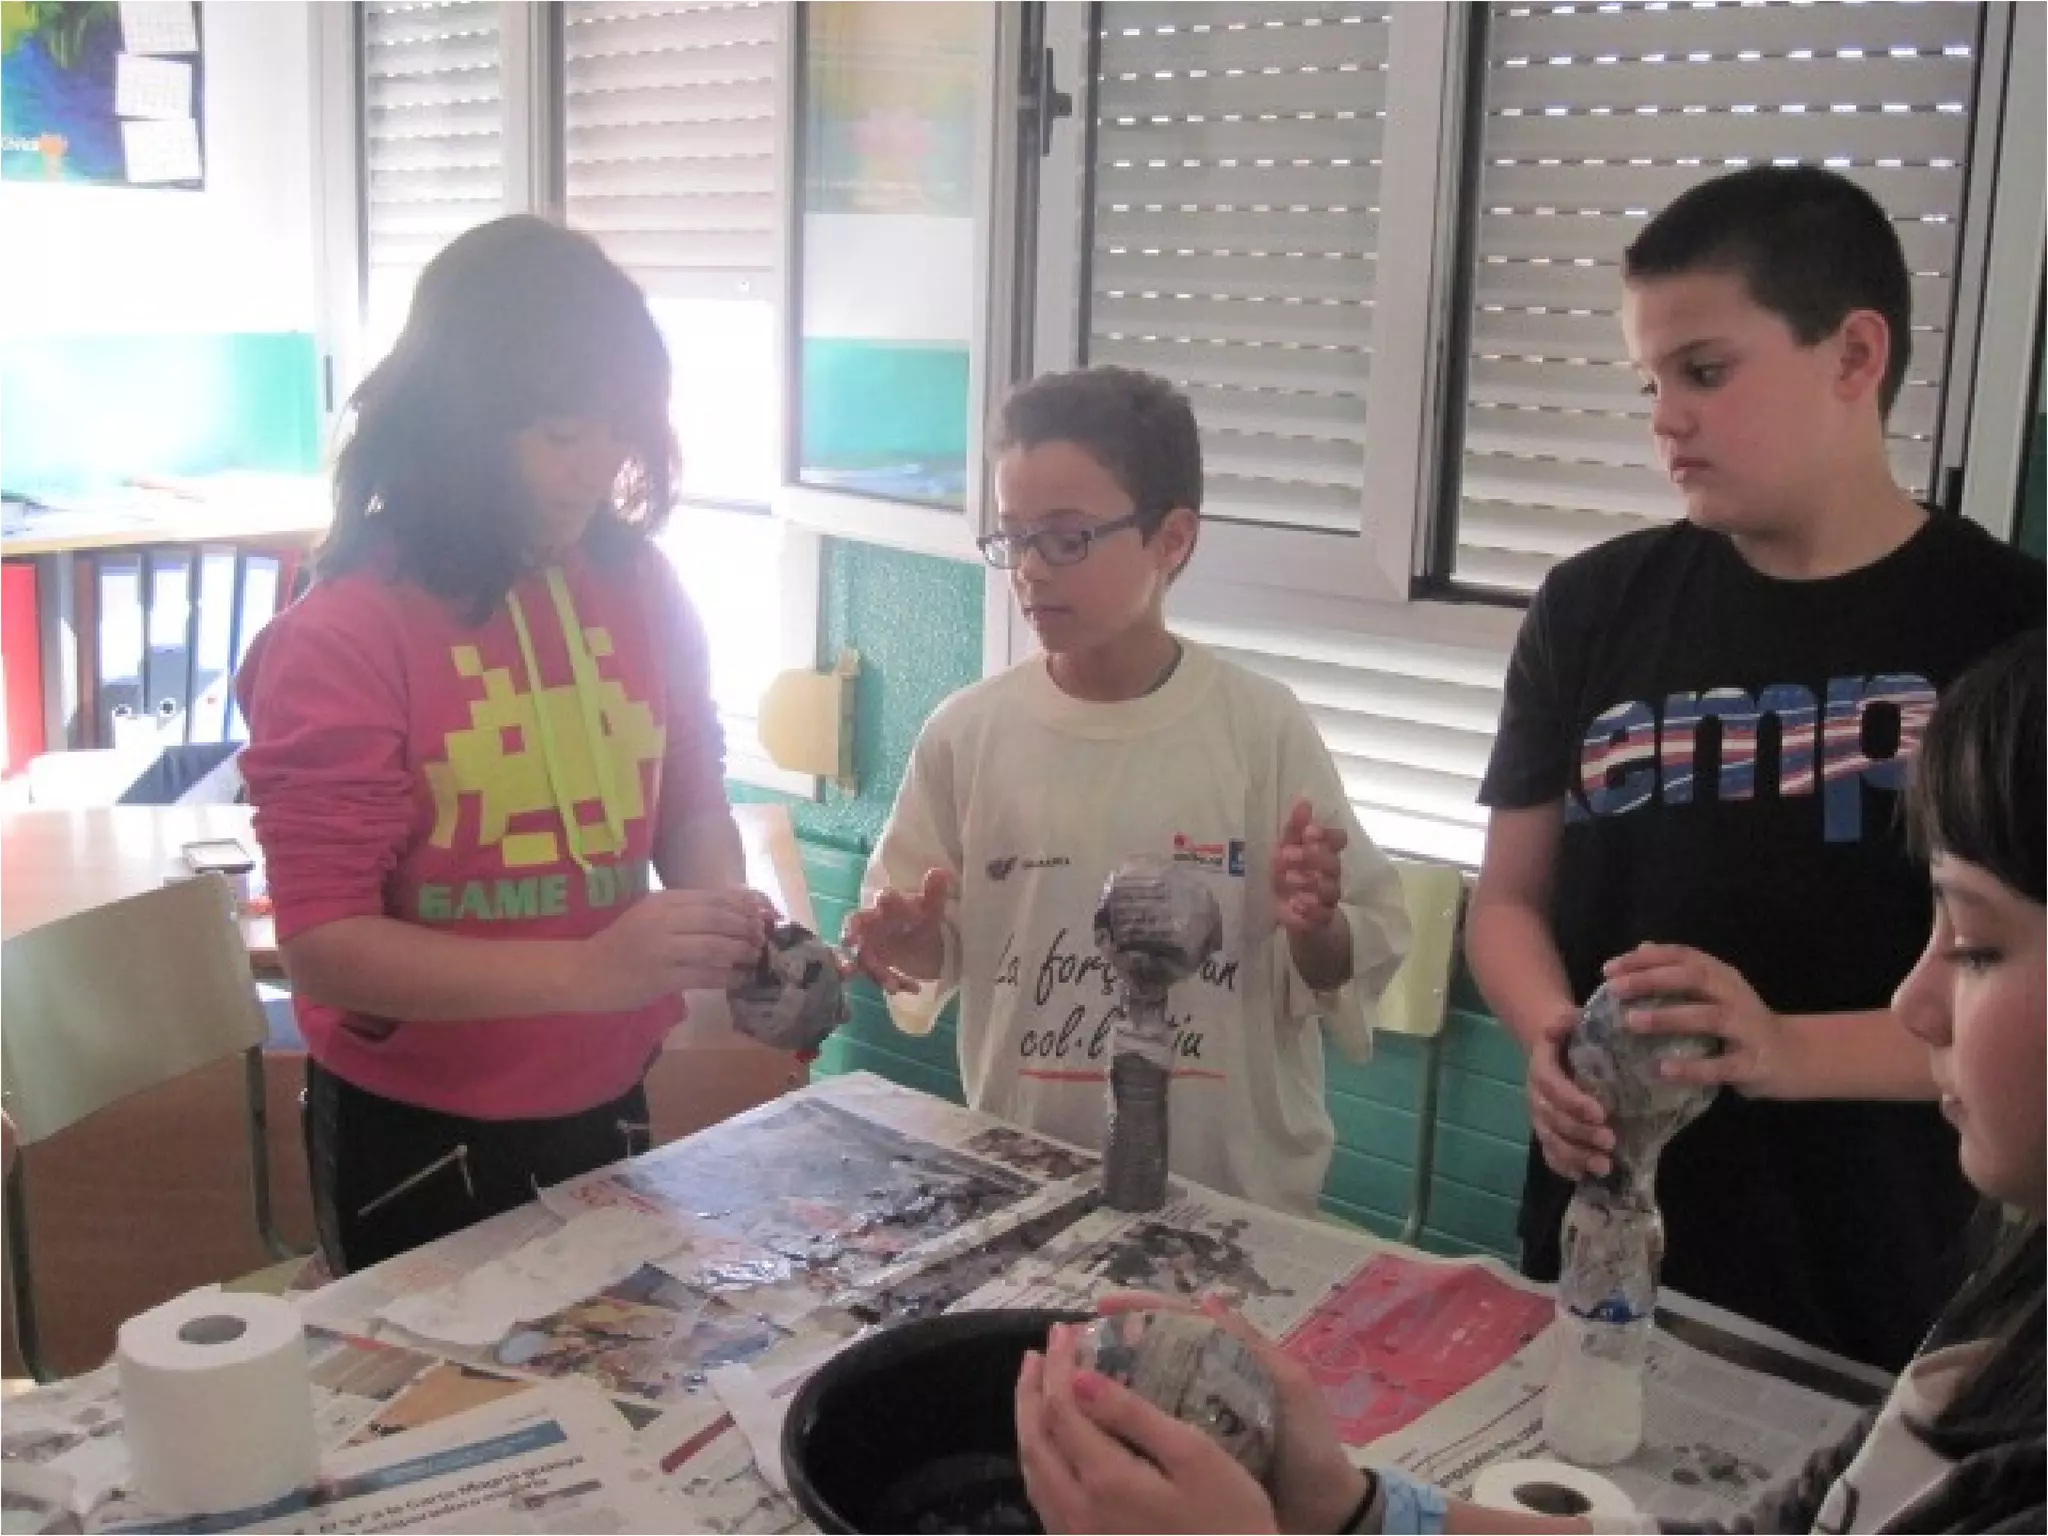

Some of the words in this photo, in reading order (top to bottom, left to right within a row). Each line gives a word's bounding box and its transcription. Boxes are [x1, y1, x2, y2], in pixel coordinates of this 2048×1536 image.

[418, 873, 569, 922] GAME
[1036, 928, 1118, 1006] forç
[1020, 1004, 1205, 1060] col·liu
